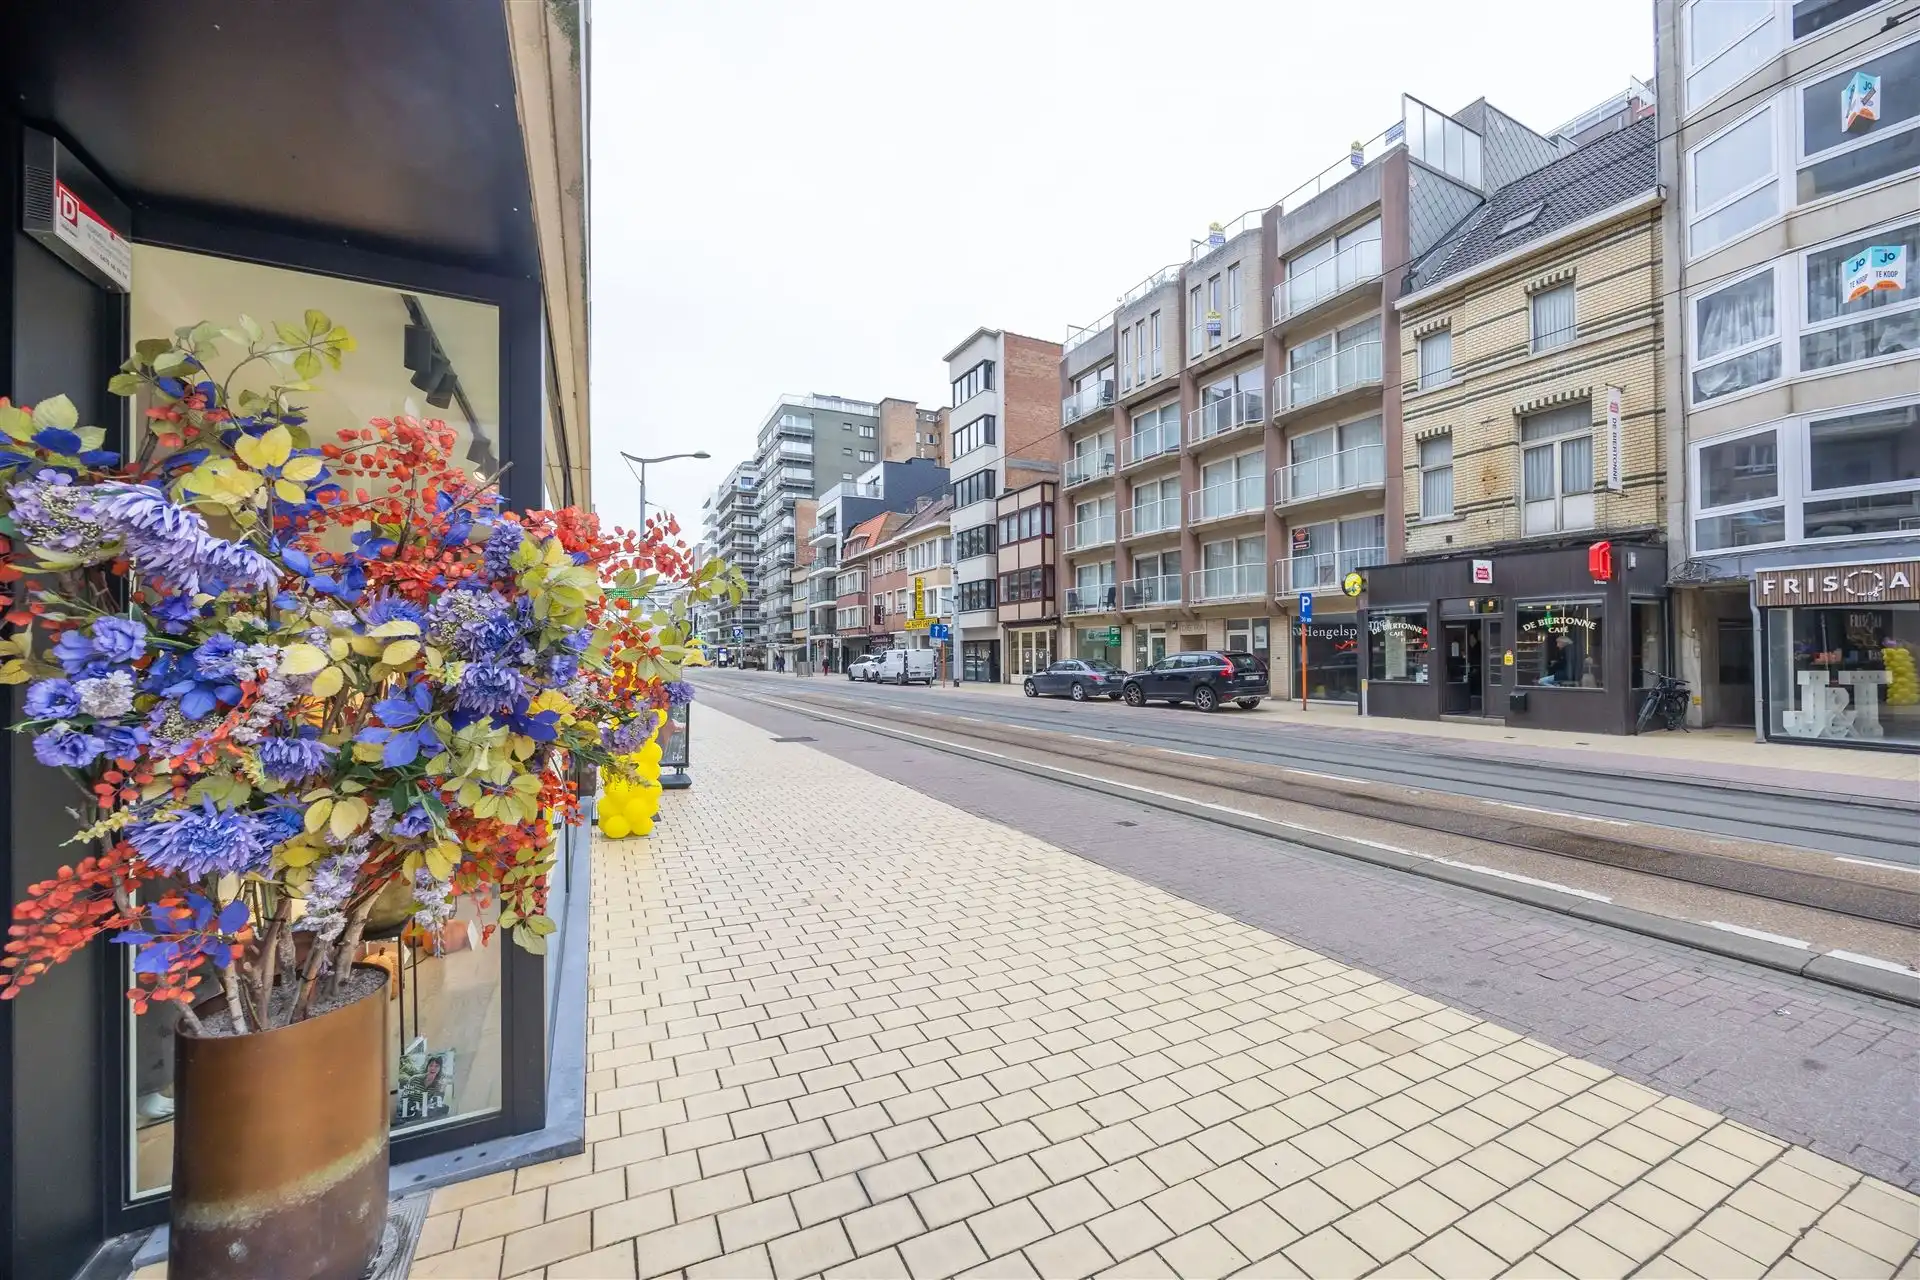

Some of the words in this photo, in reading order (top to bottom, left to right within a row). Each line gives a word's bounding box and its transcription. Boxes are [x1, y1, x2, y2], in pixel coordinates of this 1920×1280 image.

[63, 194, 76, 221] D
[1856, 273, 1869, 285] KOOP
[1612, 418, 1617, 430] DE
[1302, 596, 1311, 612] P
[1522, 622, 1537, 632] DE
[1538, 616, 1597, 630] BIERTONNE
